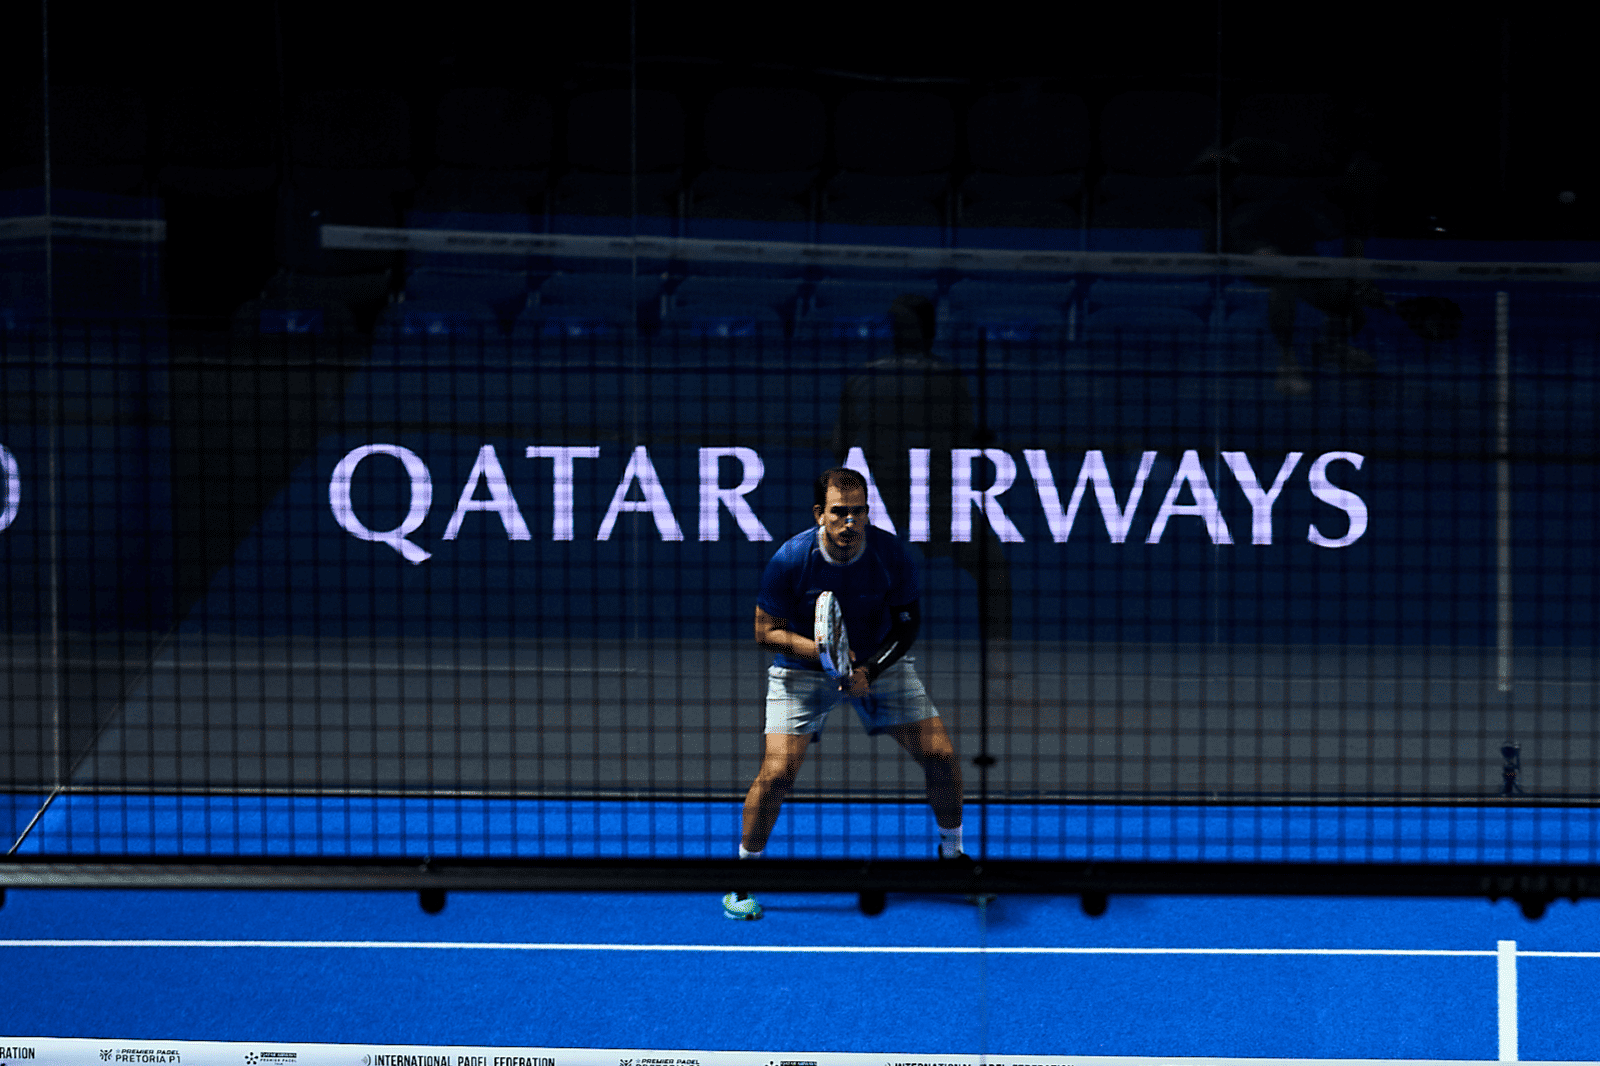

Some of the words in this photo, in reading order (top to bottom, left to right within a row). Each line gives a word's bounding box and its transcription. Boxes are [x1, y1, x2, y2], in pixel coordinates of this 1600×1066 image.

[329, 443, 774, 564] QATAR
[116, 1055, 166, 1063] PRETORIA
[169, 1056, 181, 1064] P1
[375, 1055, 452, 1066] INTERNATIONAL
